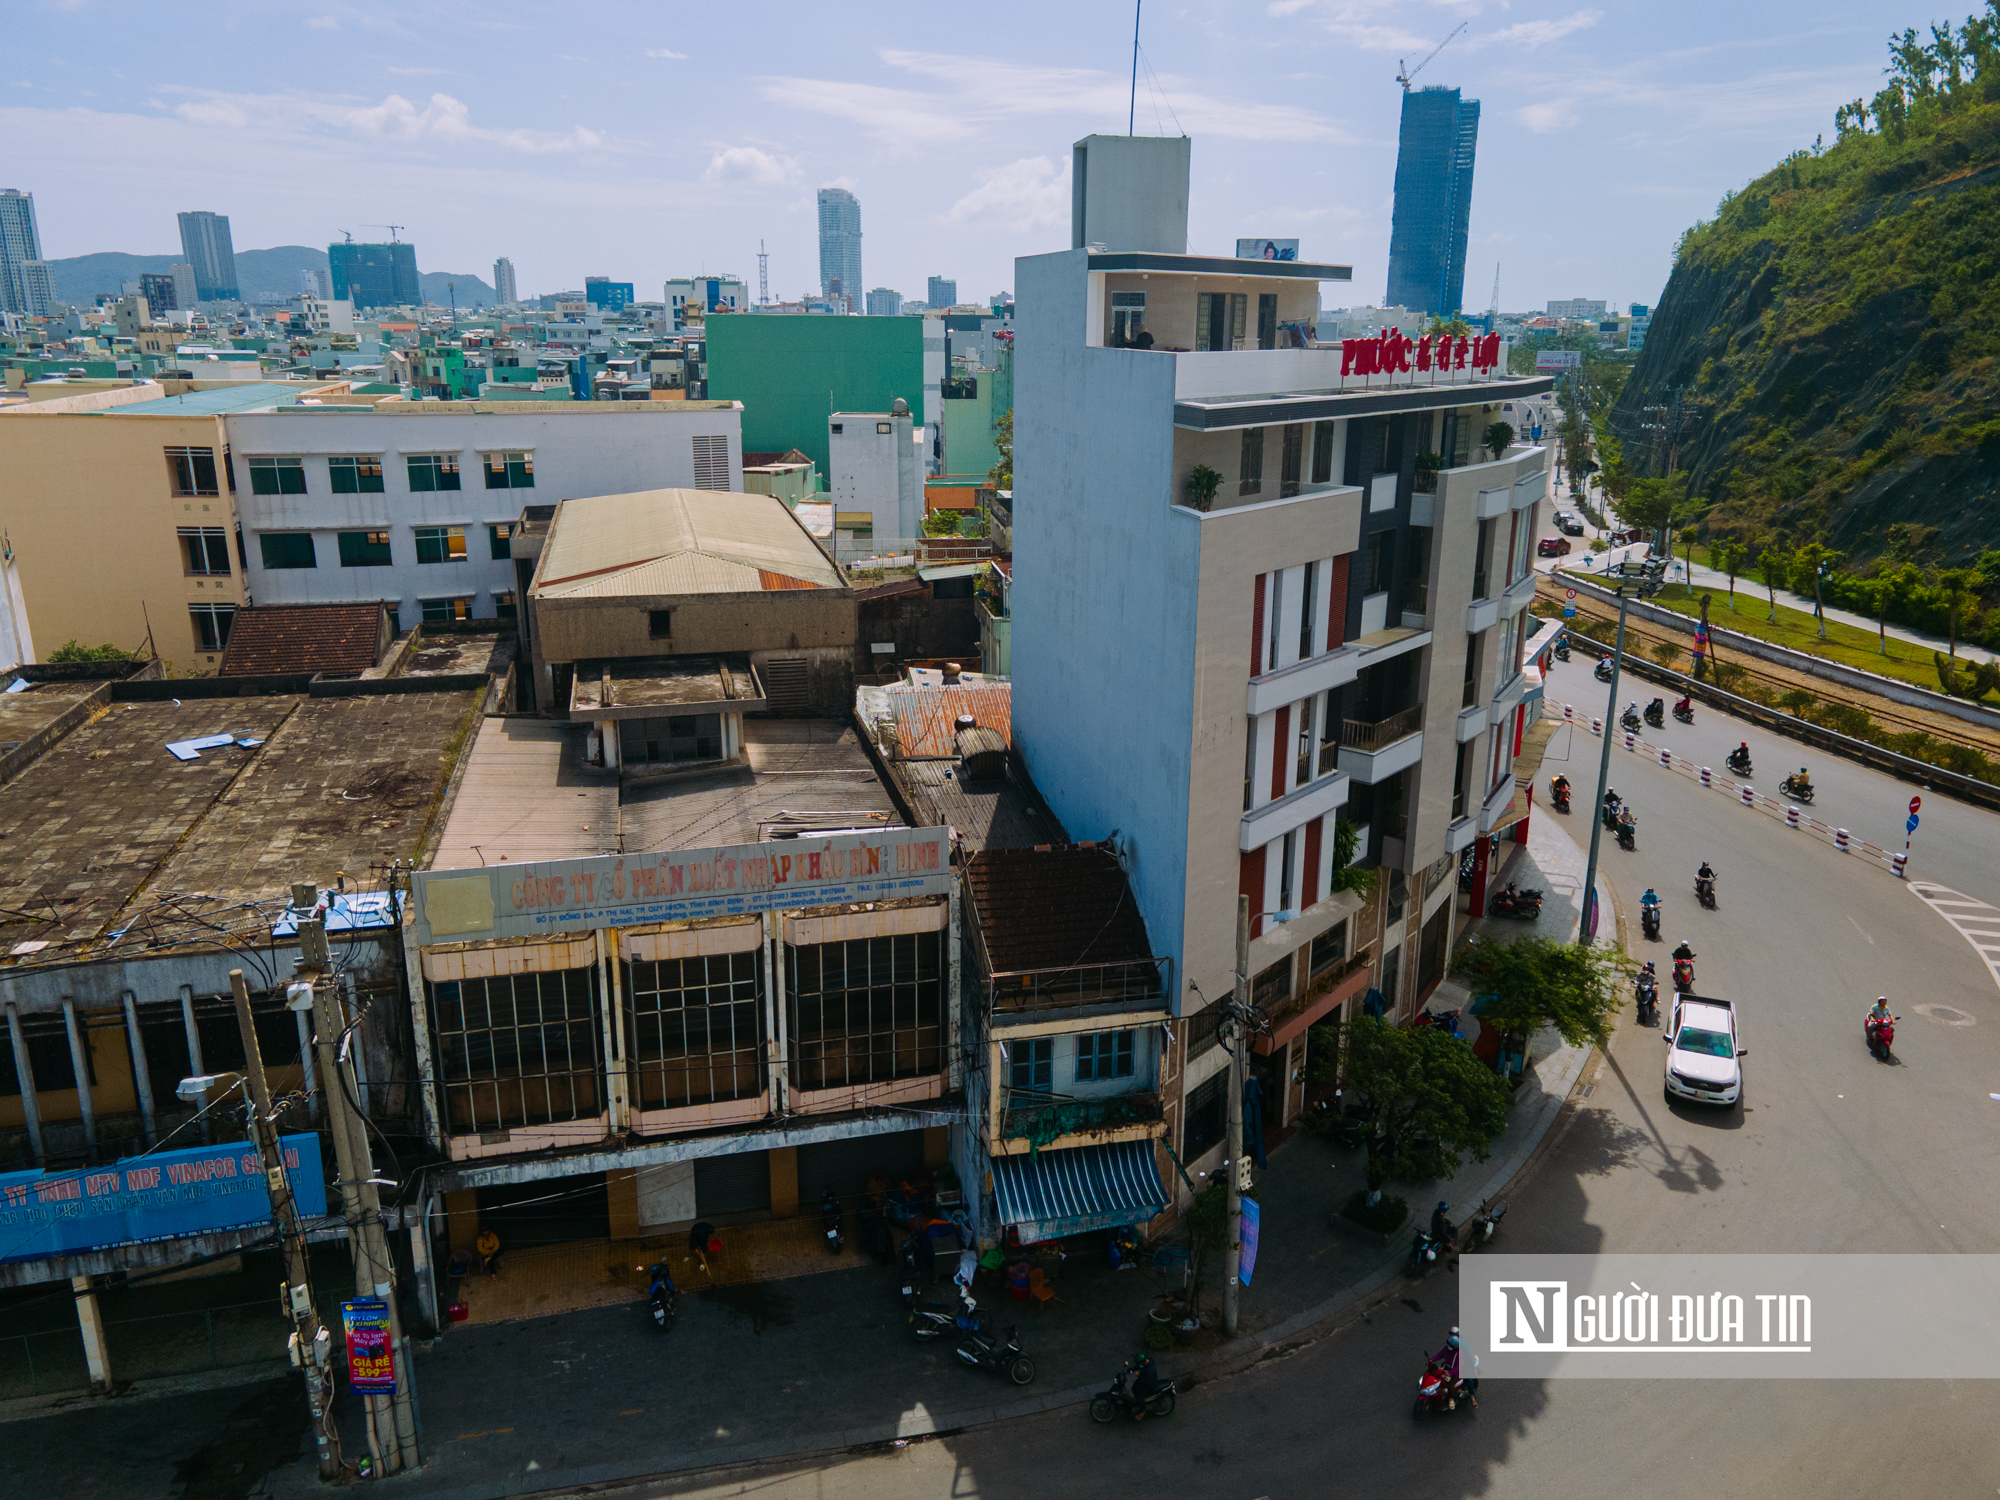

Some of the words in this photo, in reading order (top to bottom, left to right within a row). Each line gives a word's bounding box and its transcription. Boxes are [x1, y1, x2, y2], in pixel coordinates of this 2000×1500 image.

[512, 871, 566, 909] CÔNG
[570, 872, 596, 903] TY
[631, 855, 683, 898] PHẦN
[688, 849, 737, 891] XUẤT
[741, 851, 791, 889] NHẬP
[897, 841, 939, 876] ĐỊNH
[648, 905, 664, 913] QUY
[4, 1184, 27, 1207] TY
[33, 1178, 82, 1203] TNHH
[85, 1172, 120, 1197] MTV
[127, 1167, 161, 1191] MDF
[166, 1157, 237, 1185] VINAFOR
[241, 1153, 260, 1175] GI
